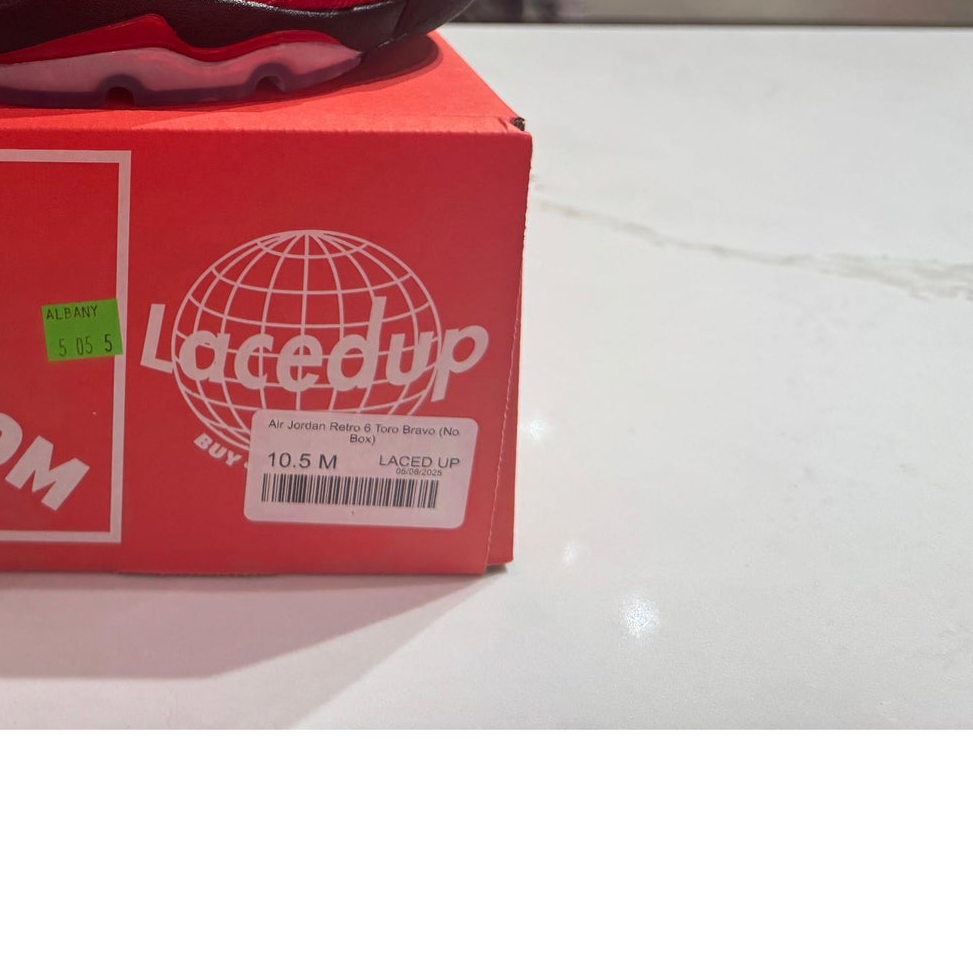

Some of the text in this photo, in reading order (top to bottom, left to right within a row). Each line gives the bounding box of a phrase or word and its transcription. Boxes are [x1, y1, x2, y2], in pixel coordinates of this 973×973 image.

[46, 304, 98, 320] ALBANY
[58, 338, 67, 358] 5
[104, 333, 113, 353] 5
[140, 296, 490, 403] Lacedup
[268, 419, 460, 438] Air Jordan Retro 6 Toro Bravo (No
[349, 433, 376, 446] Box)
[193, 433, 243, 466] BUY
[267, 451, 338, 470] 10.5 M
[379, 454, 461, 470] LACED UP
